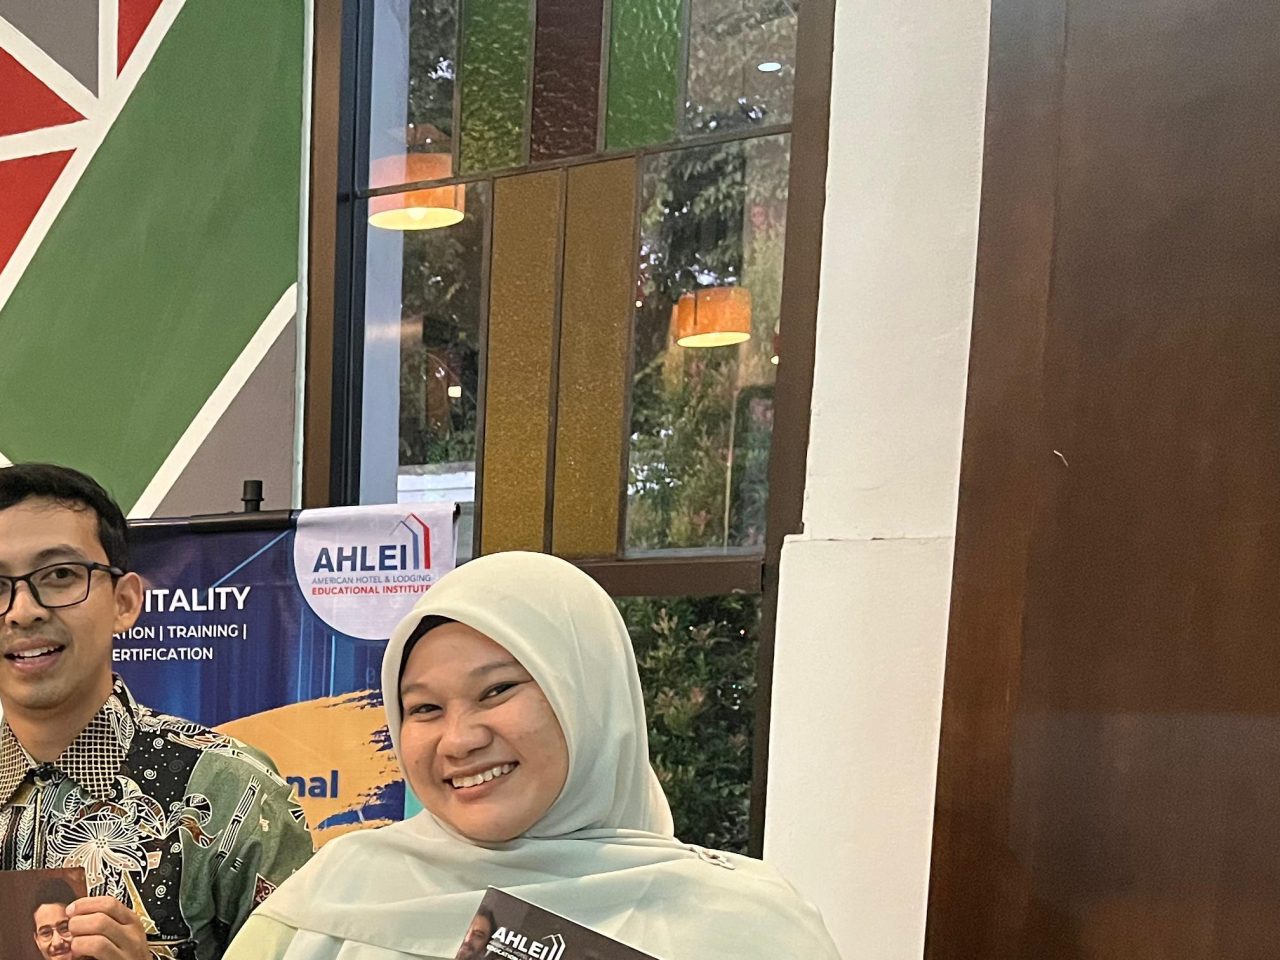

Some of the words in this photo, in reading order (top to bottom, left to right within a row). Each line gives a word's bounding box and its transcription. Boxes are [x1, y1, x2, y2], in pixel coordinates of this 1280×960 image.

[312, 544, 407, 573] AHLEI
[311, 577, 354, 585] AMERICAN
[355, 576, 381, 584] HOTEL
[384, 575, 391, 583] &
[393, 574, 431, 583] LODGING
[312, 586, 380, 595] EDUCATIONAL
[167, 624, 239, 638] TRAINING
[491, 926, 550, 960] AHLEI
